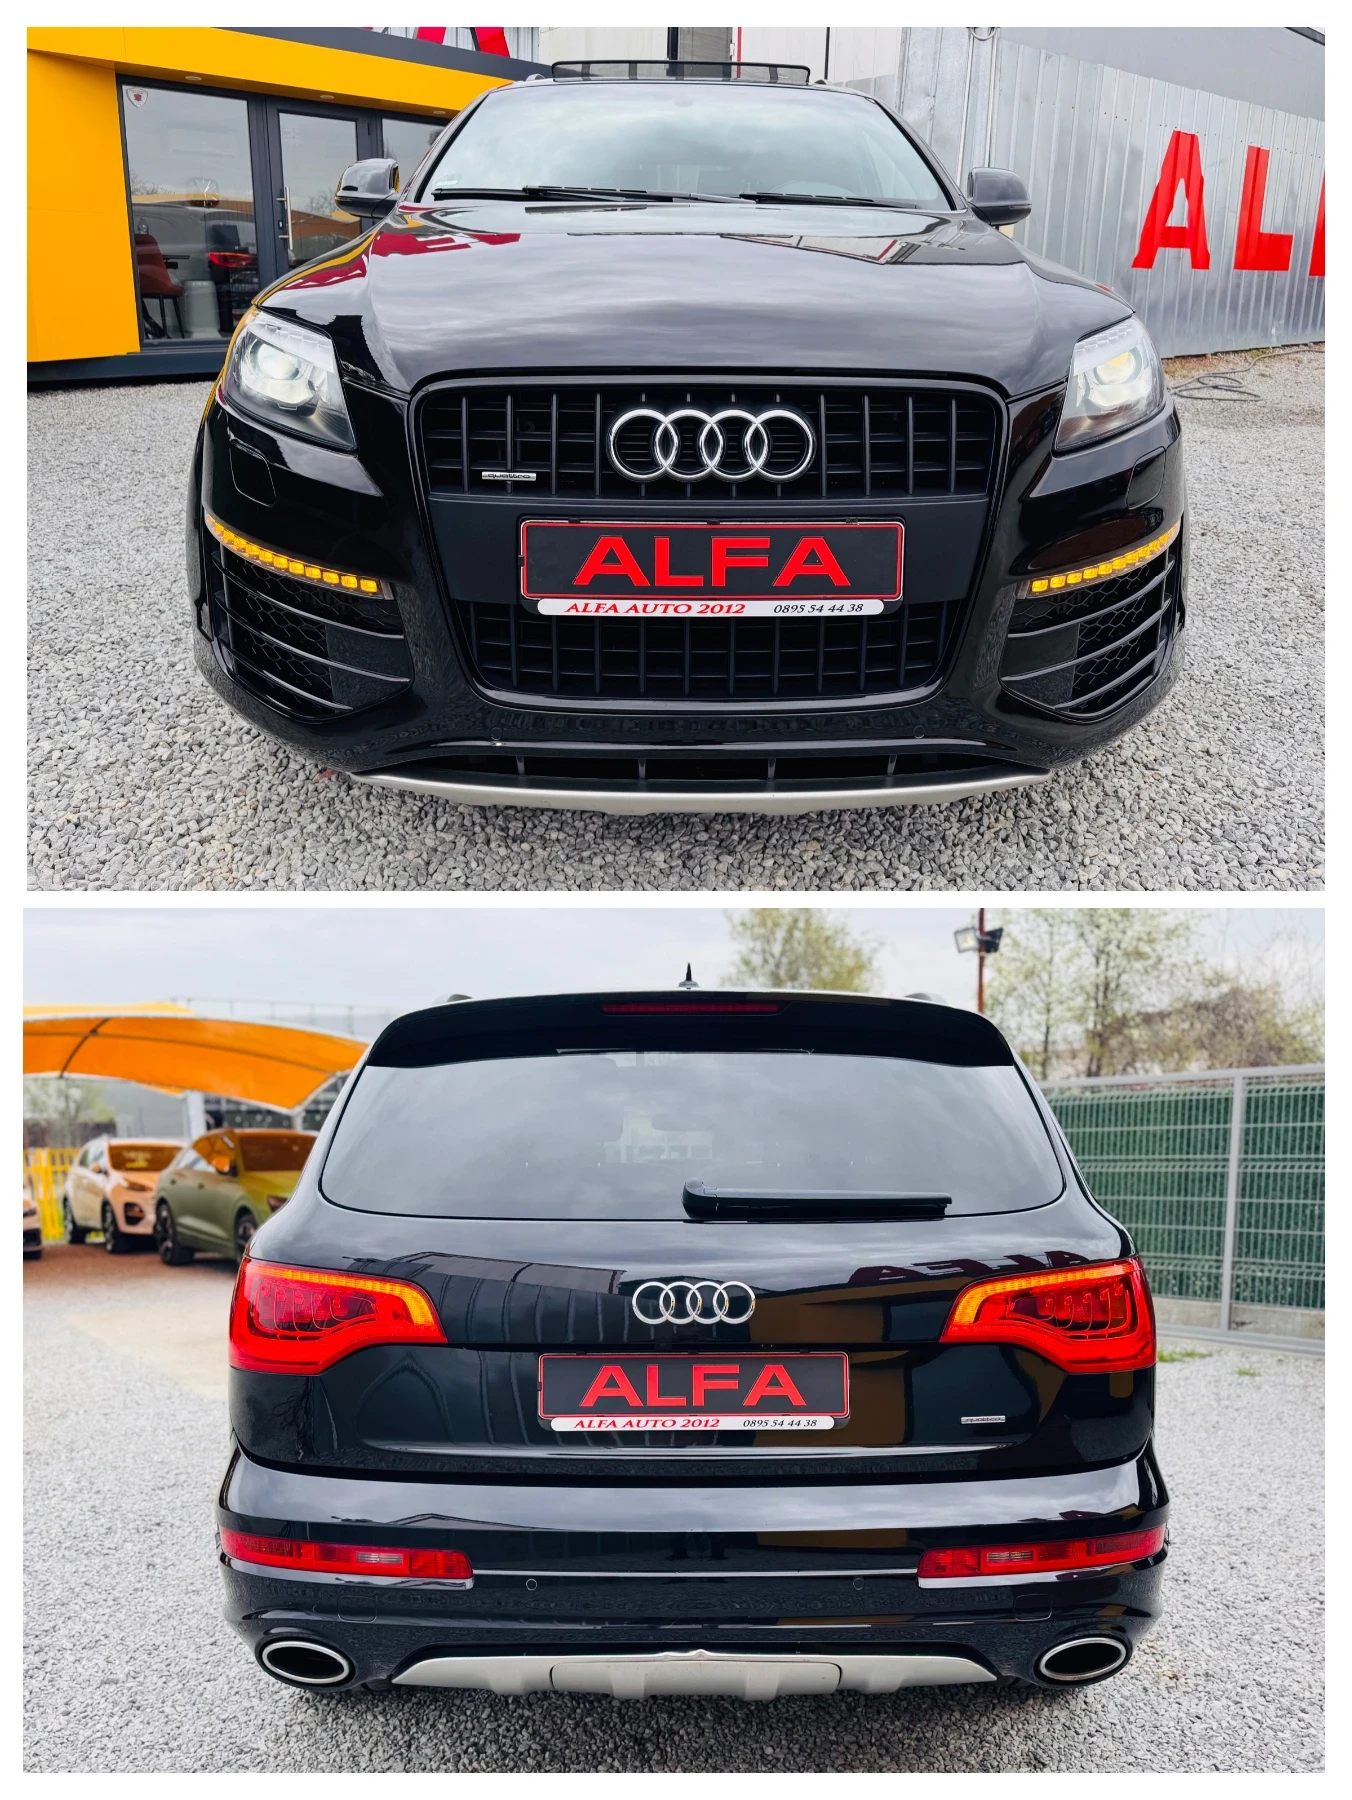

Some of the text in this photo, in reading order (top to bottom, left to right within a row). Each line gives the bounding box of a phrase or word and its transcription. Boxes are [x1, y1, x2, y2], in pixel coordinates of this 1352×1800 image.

[1131, 130, 1325, 277] AL
[572, 535, 851, 587] ALFA
[564, 602, 746, 614] ALFA AUTO 2012
[773, 603, 864, 614] 0895 54 44 38
[579, 1364, 807, 1407] ALFA
[573, 1418, 721, 1429] ALFA AUTO 2012
[742, 1419, 818, 1428] 0895 54 44 38
